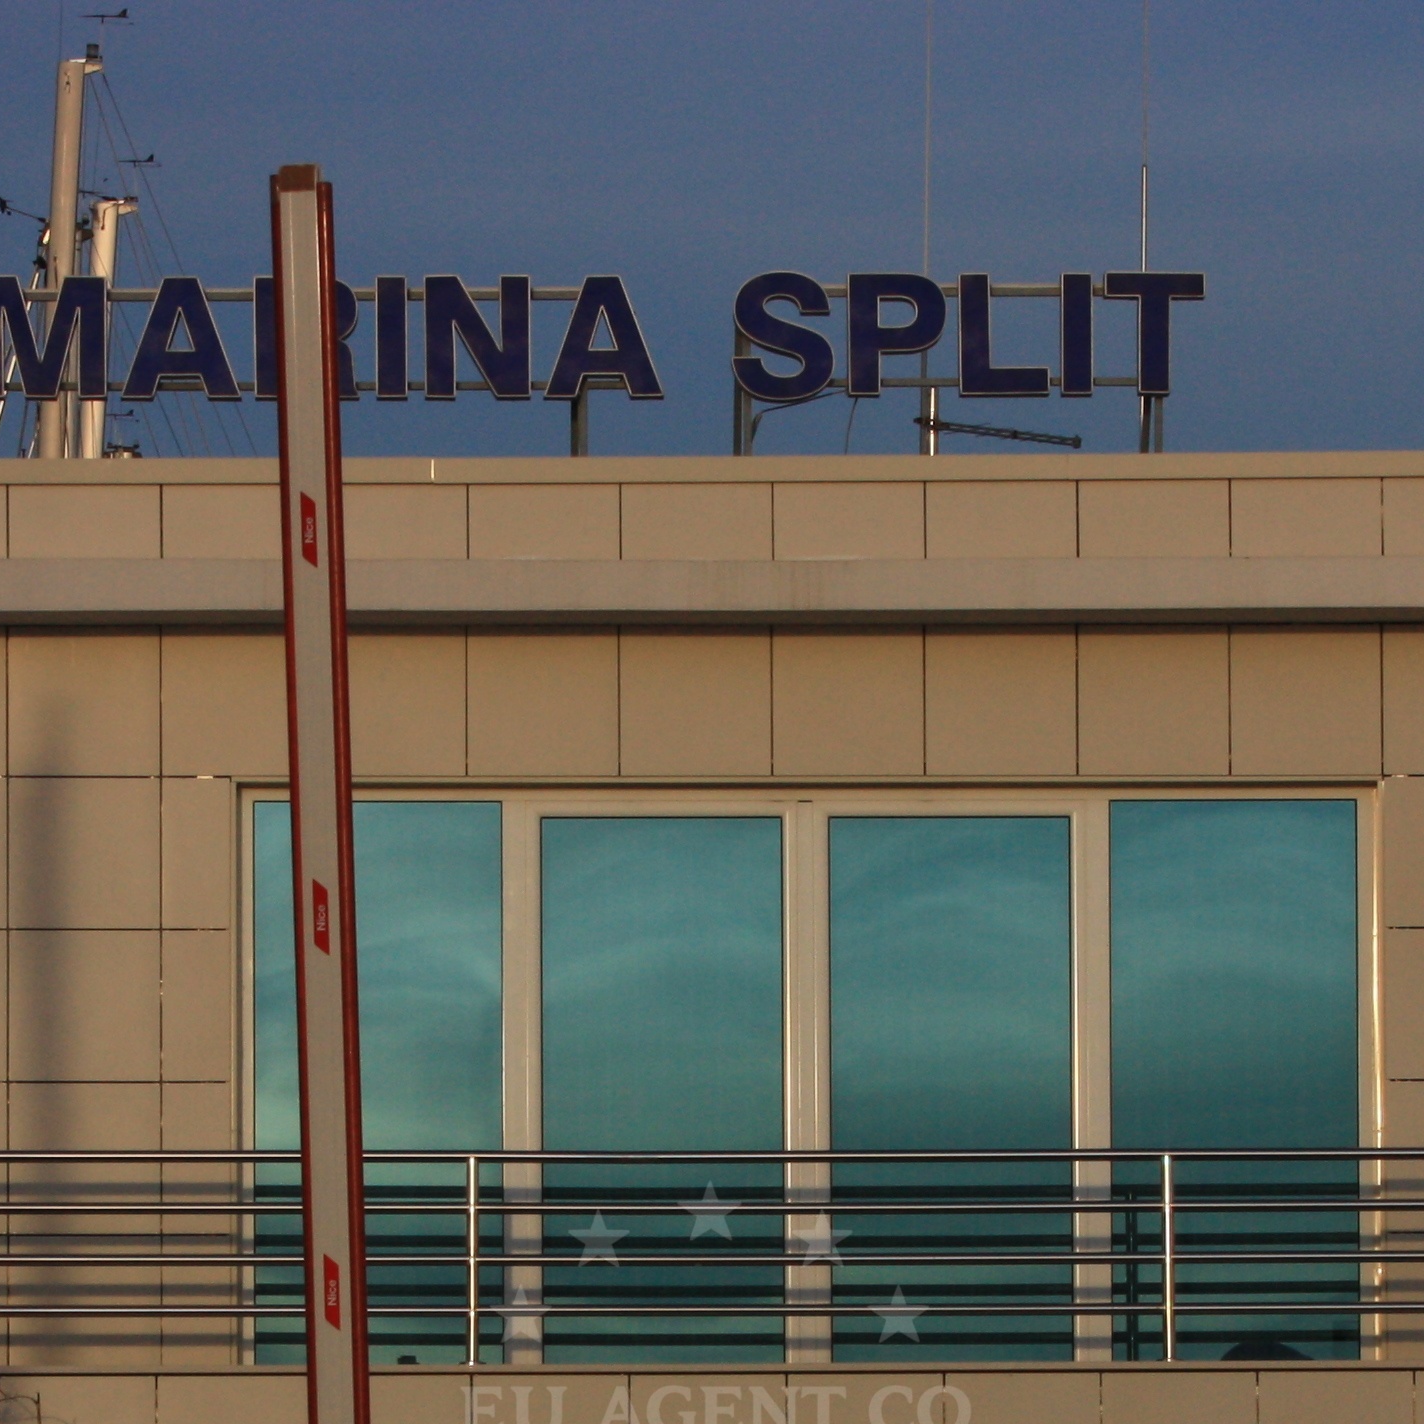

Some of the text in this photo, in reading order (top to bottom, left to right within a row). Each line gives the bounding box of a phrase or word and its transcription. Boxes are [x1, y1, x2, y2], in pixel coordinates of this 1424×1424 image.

[731, 271, 1205, 402] SPLIT
[304, 517, 314, 544] Nice
[316, 904, 326, 932] Nice
[327, 1280, 337, 1306] Nice
